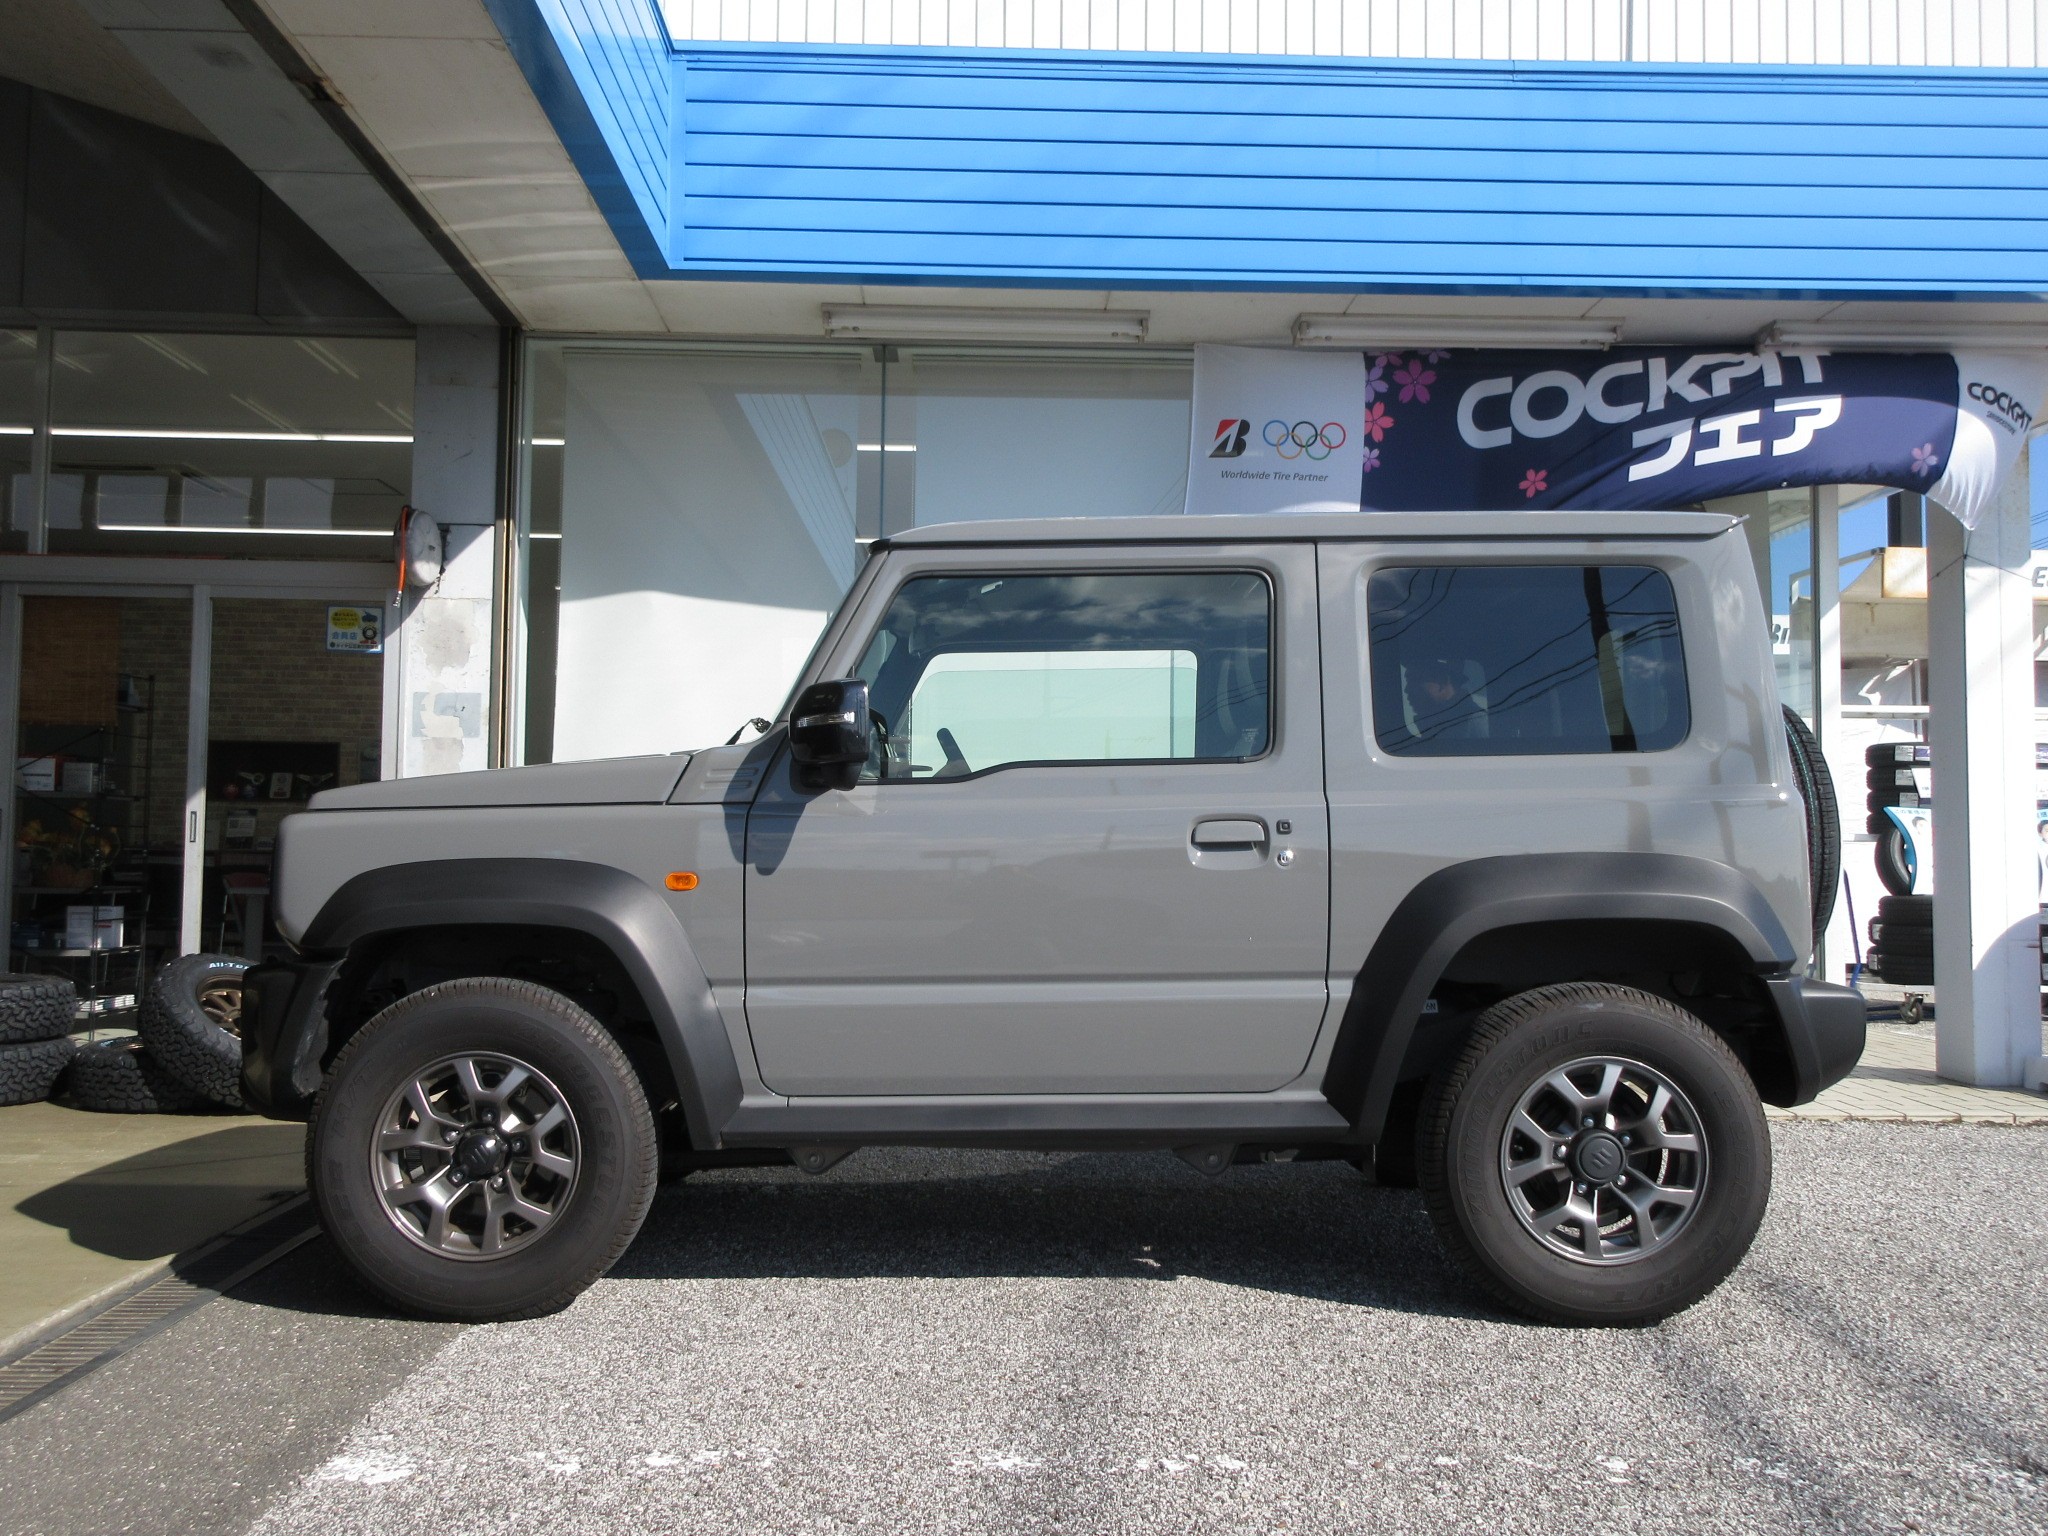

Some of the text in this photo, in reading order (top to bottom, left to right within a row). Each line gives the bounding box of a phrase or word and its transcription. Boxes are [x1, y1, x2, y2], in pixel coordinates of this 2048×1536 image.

[1456, 352, 1832, 450] COCKPIT
[1966, 382, 2033, 433] COCKPIT
[1221, 470, 1329, 482] Worldwide Tire Partner
